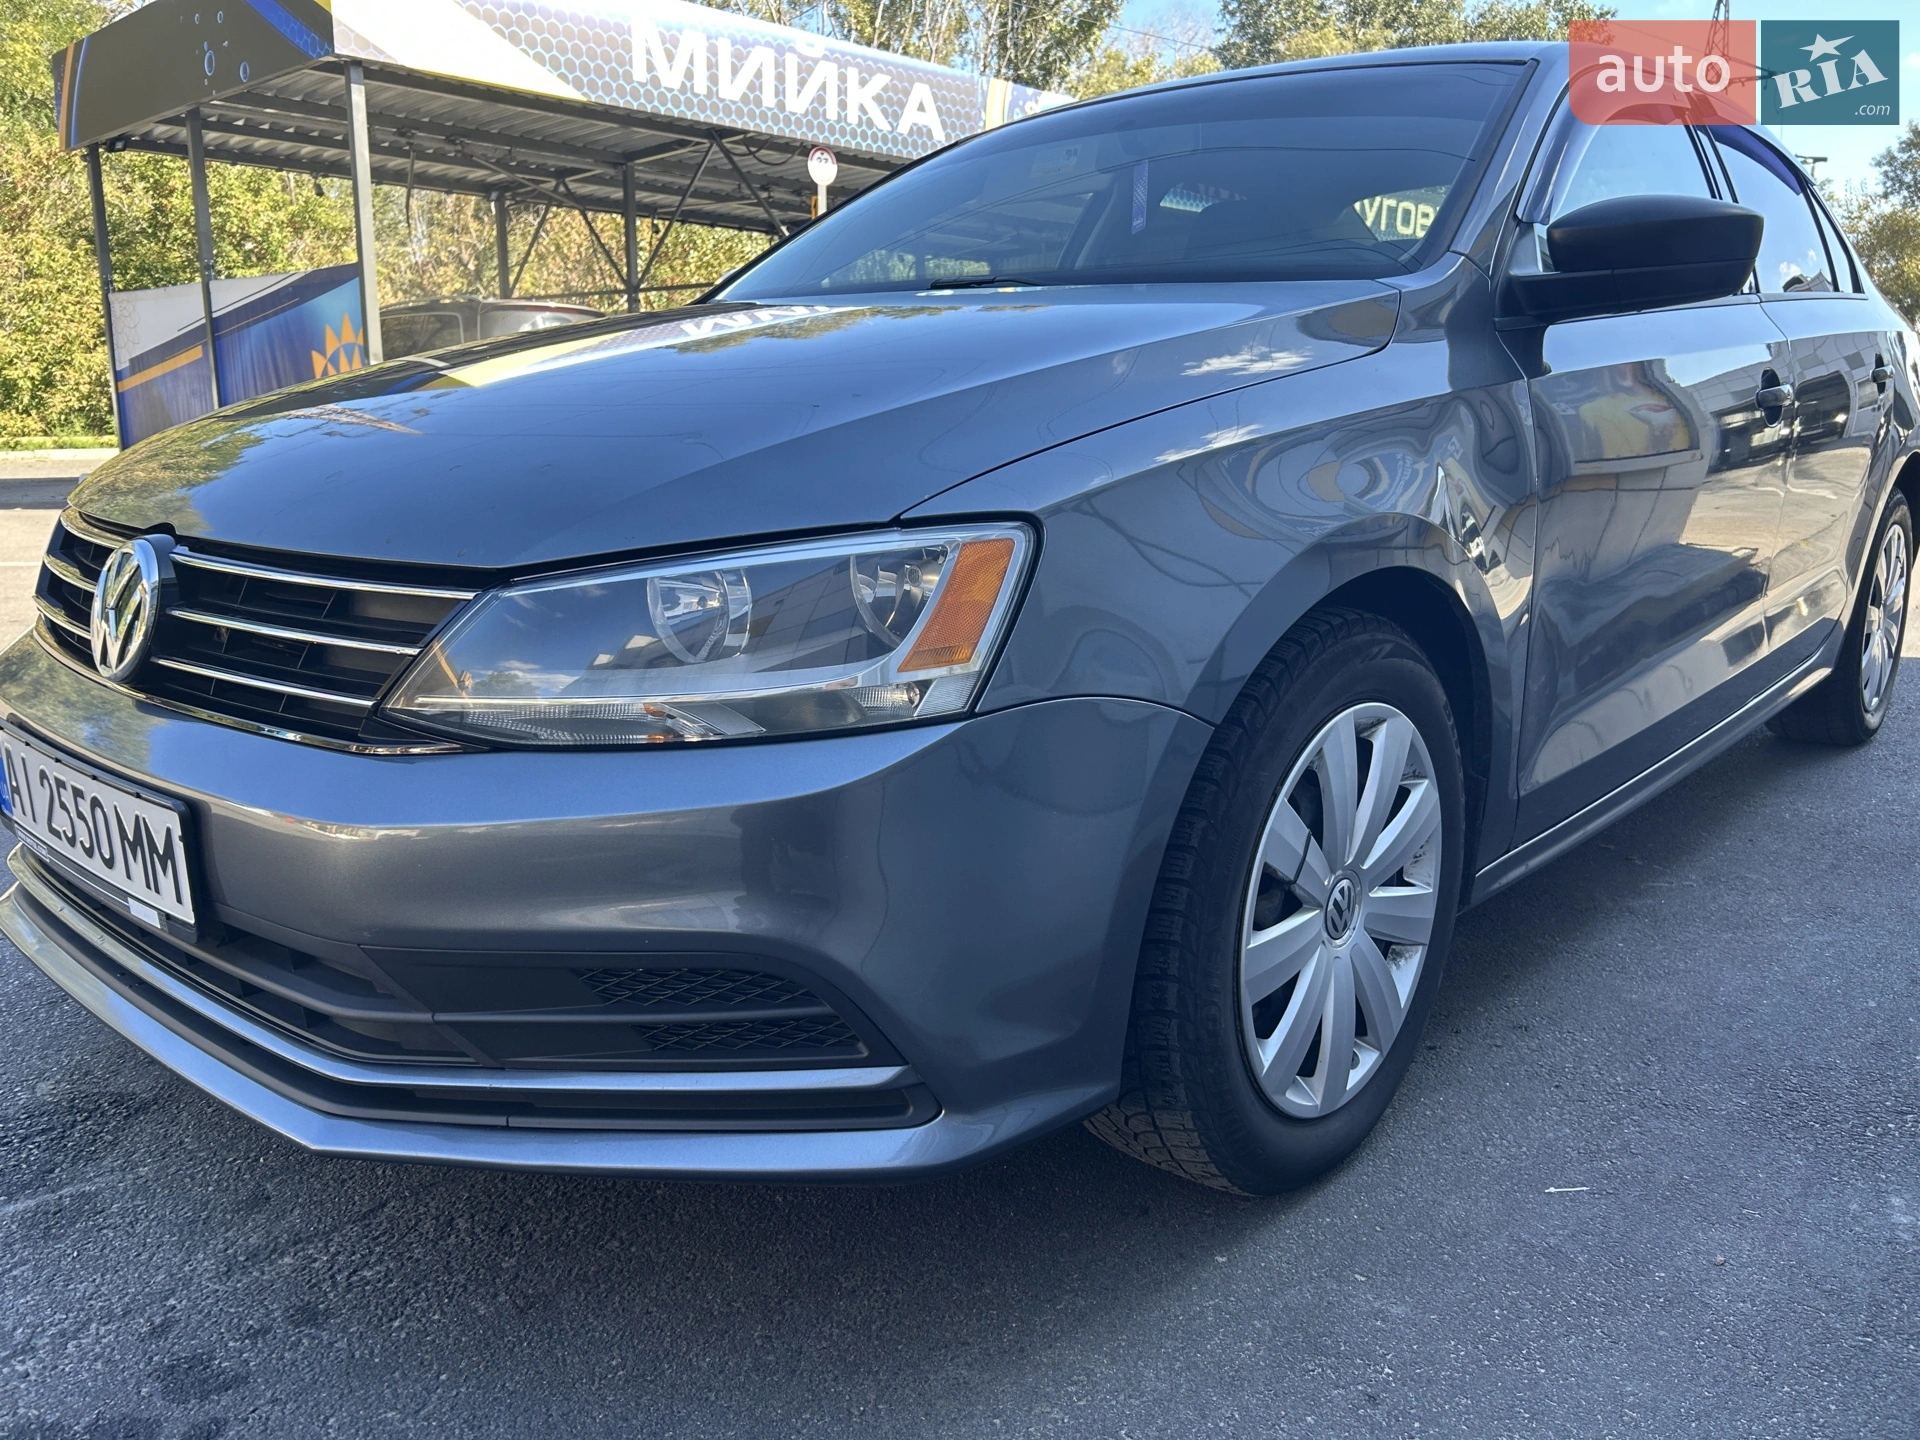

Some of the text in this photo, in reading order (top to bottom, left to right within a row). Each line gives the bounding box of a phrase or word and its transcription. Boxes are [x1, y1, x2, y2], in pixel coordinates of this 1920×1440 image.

[631, 15, 946, 142] МИЙКА
[1353, 195, 1440, 238] УГОВ
[4, 744, 183, 906] AI 2550 MM
